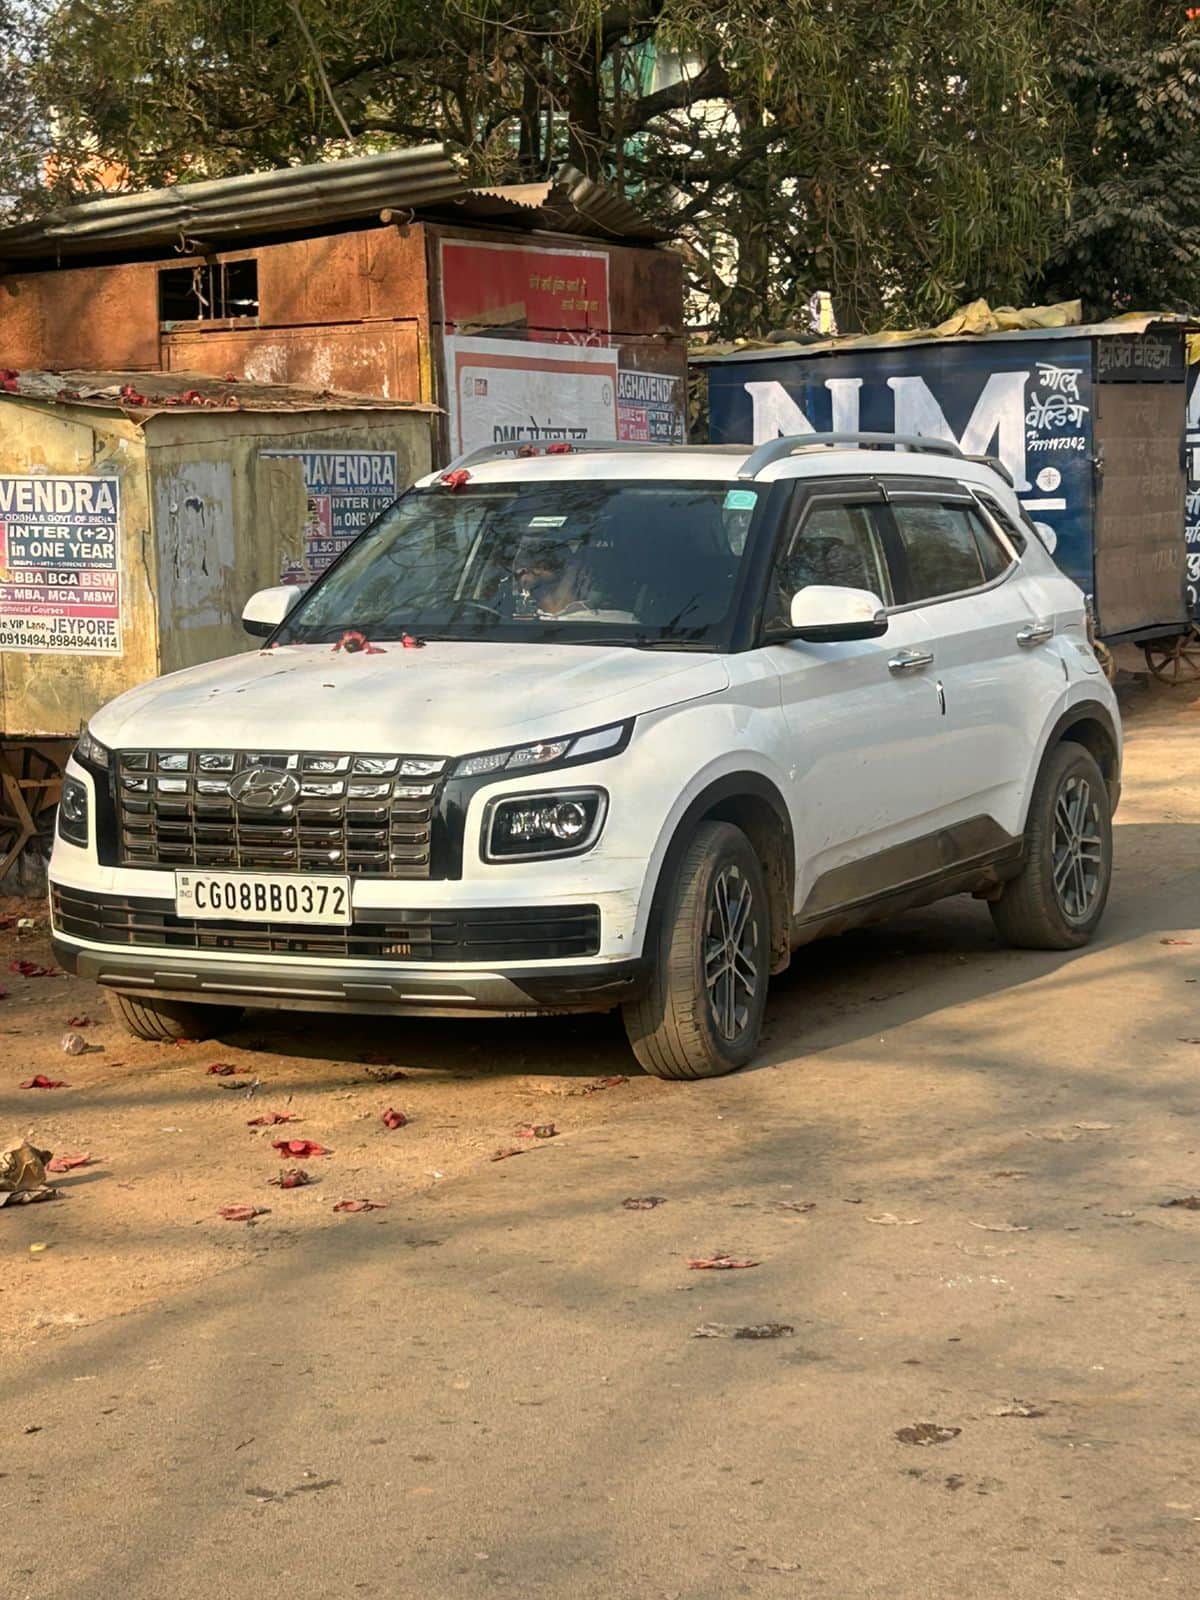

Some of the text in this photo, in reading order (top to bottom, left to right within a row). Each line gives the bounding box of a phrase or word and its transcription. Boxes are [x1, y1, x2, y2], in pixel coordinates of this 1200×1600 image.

[0, 480, 115, 513] VENDRA
[344, 513, 367, 526] ONE
[9, 525, 114, 542] INTER (+2)
[11, 541, 114, 559] in ONE YEAR
[15, 572, 45, 583] BBA
[48, 573, 78, 584] BCA
[82, 573, 116, 587] BSW
[14, 589, 45, 602] MBA,
[48, 590, 80, 602] MCA,
[84, 591, 114, 602] MSW
[9, 619, 24, 629] VIP
[50, 618, 115, 635] JEYPORE
[195, 881, 346, 915] CG08BB0372
